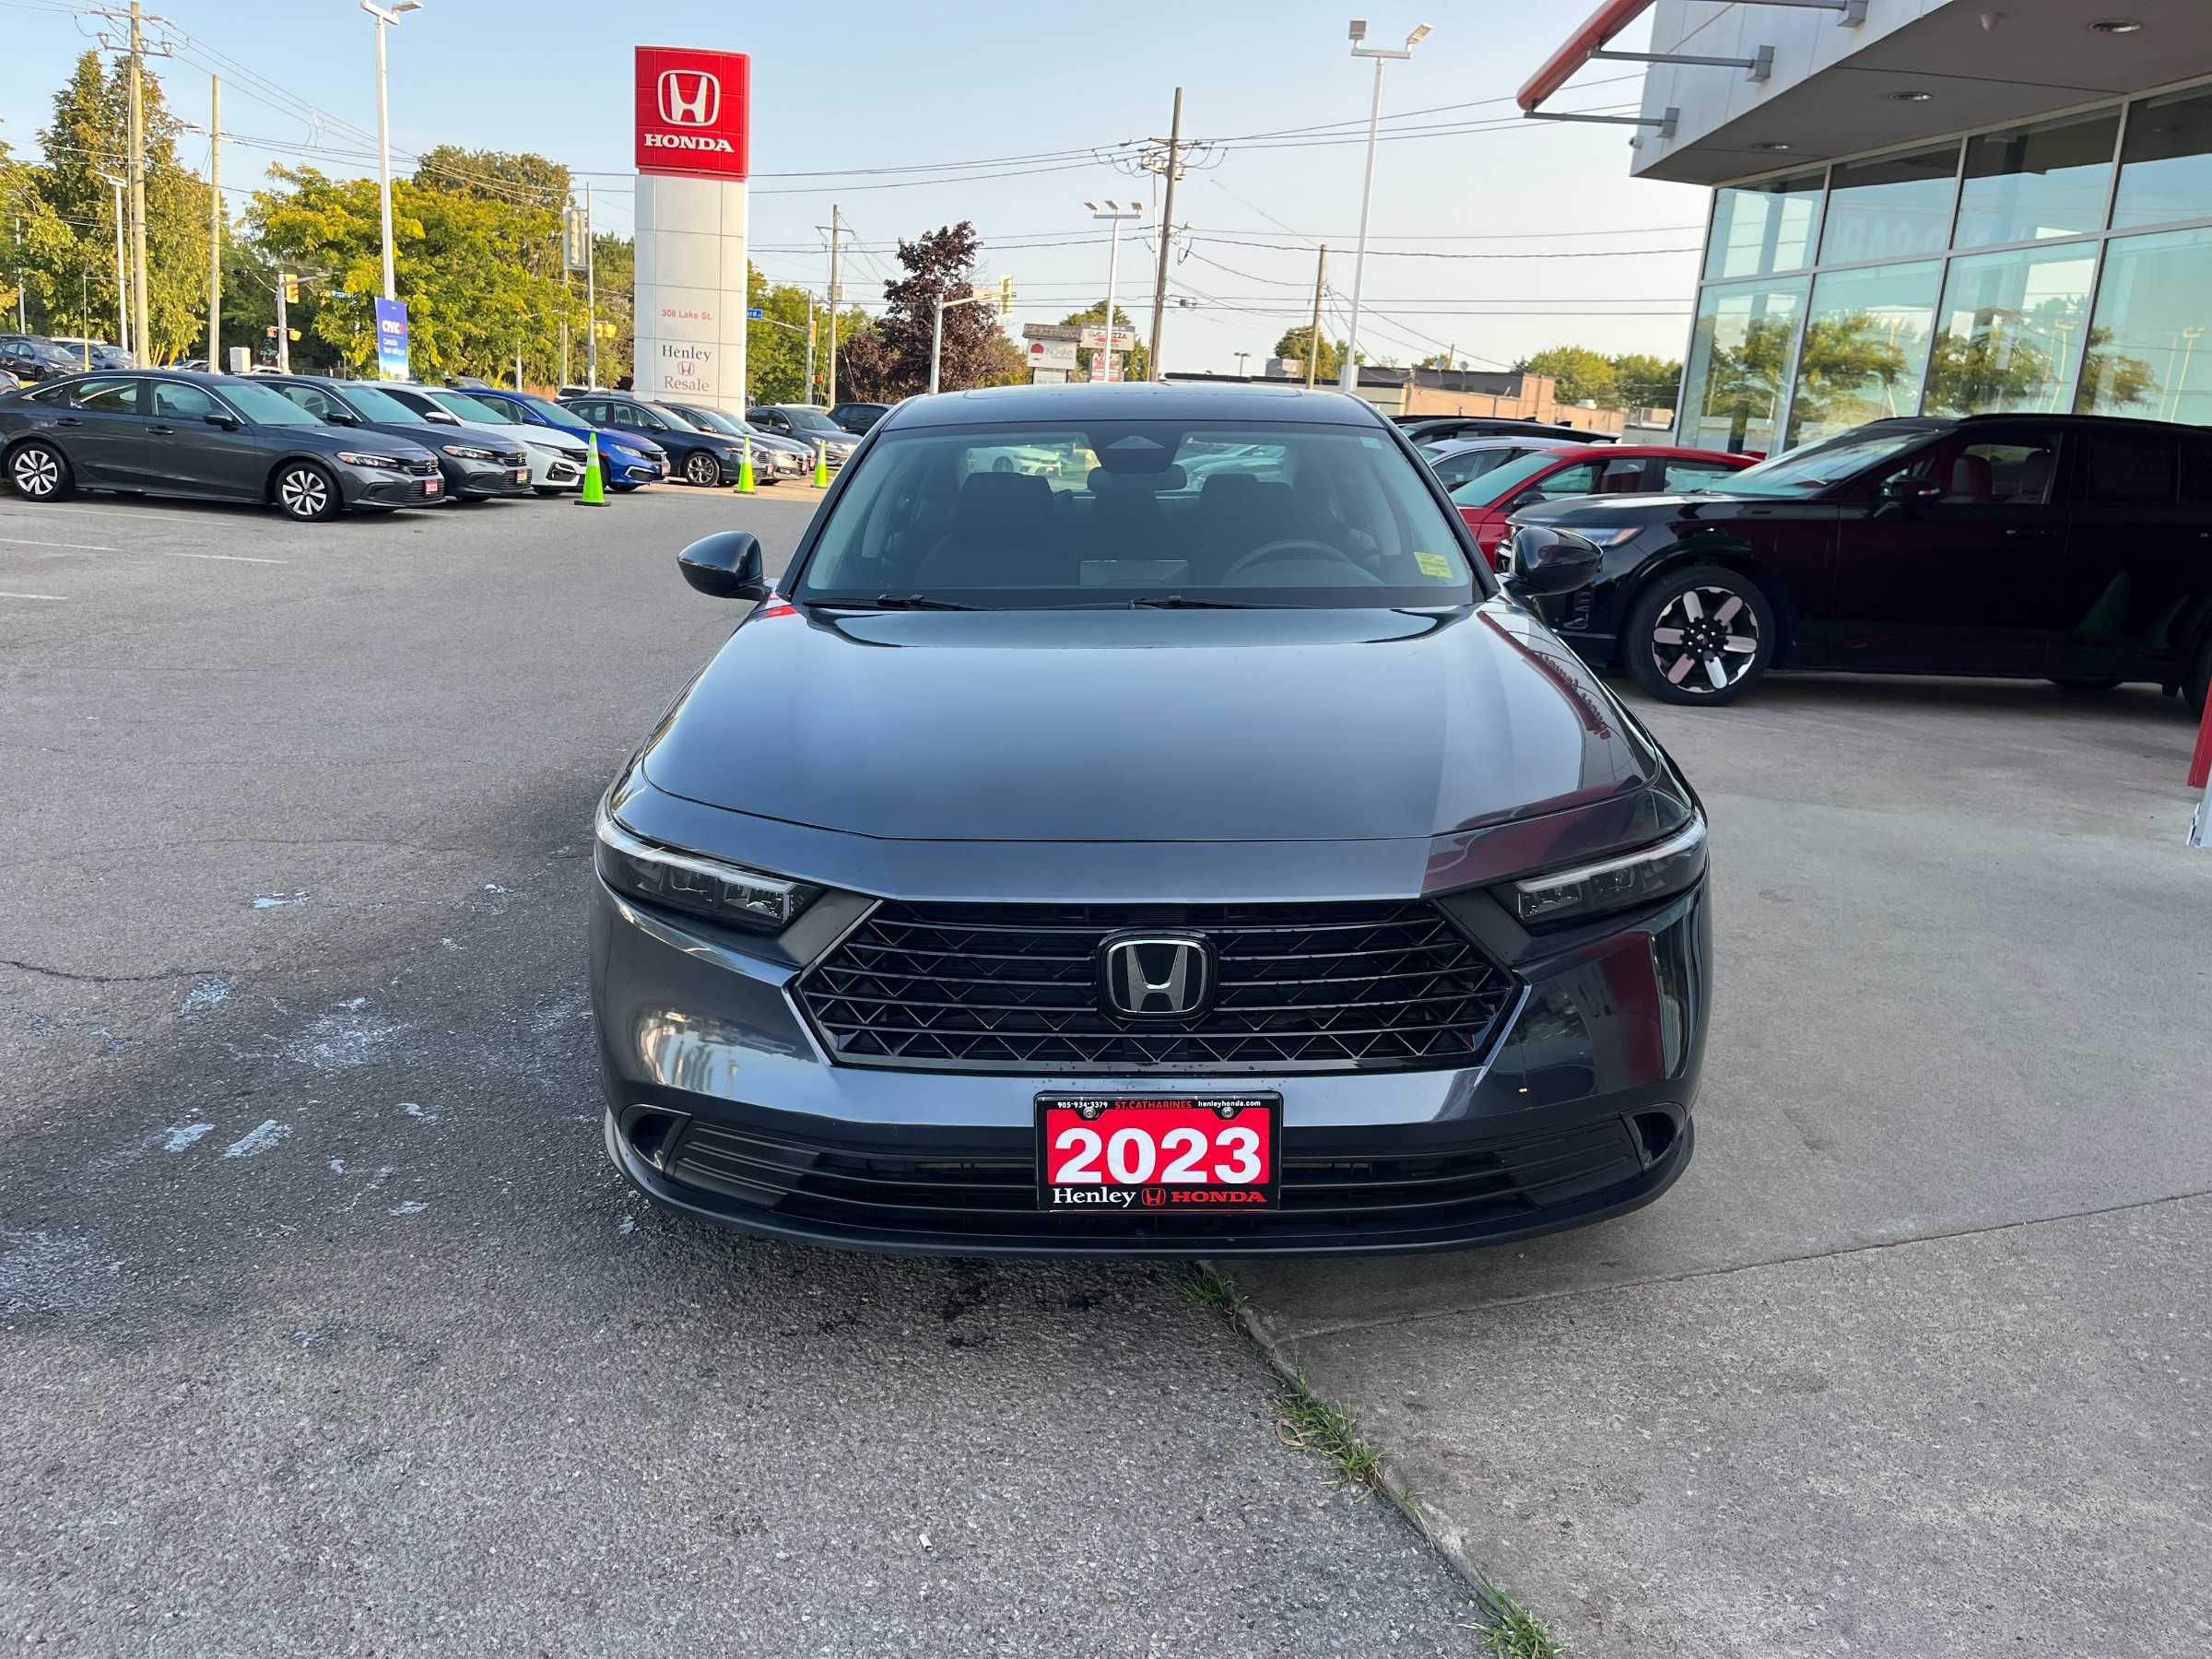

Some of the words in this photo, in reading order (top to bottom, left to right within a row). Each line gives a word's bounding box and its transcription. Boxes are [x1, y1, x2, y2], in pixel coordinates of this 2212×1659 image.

[644, 134, 735, 152] HONDA
[678, 311, 699, 319] Lake
[382, 320, 401, 335] CIVIC
[662, 345, 712, 362] Henley
[664, 375, 710, 392] Resale
[1054, 1127, 1262, 1184] 2023
[1053, 1186, 1136, 1207] Henley
[1171, 1191, 1266, 1203] HONDA
